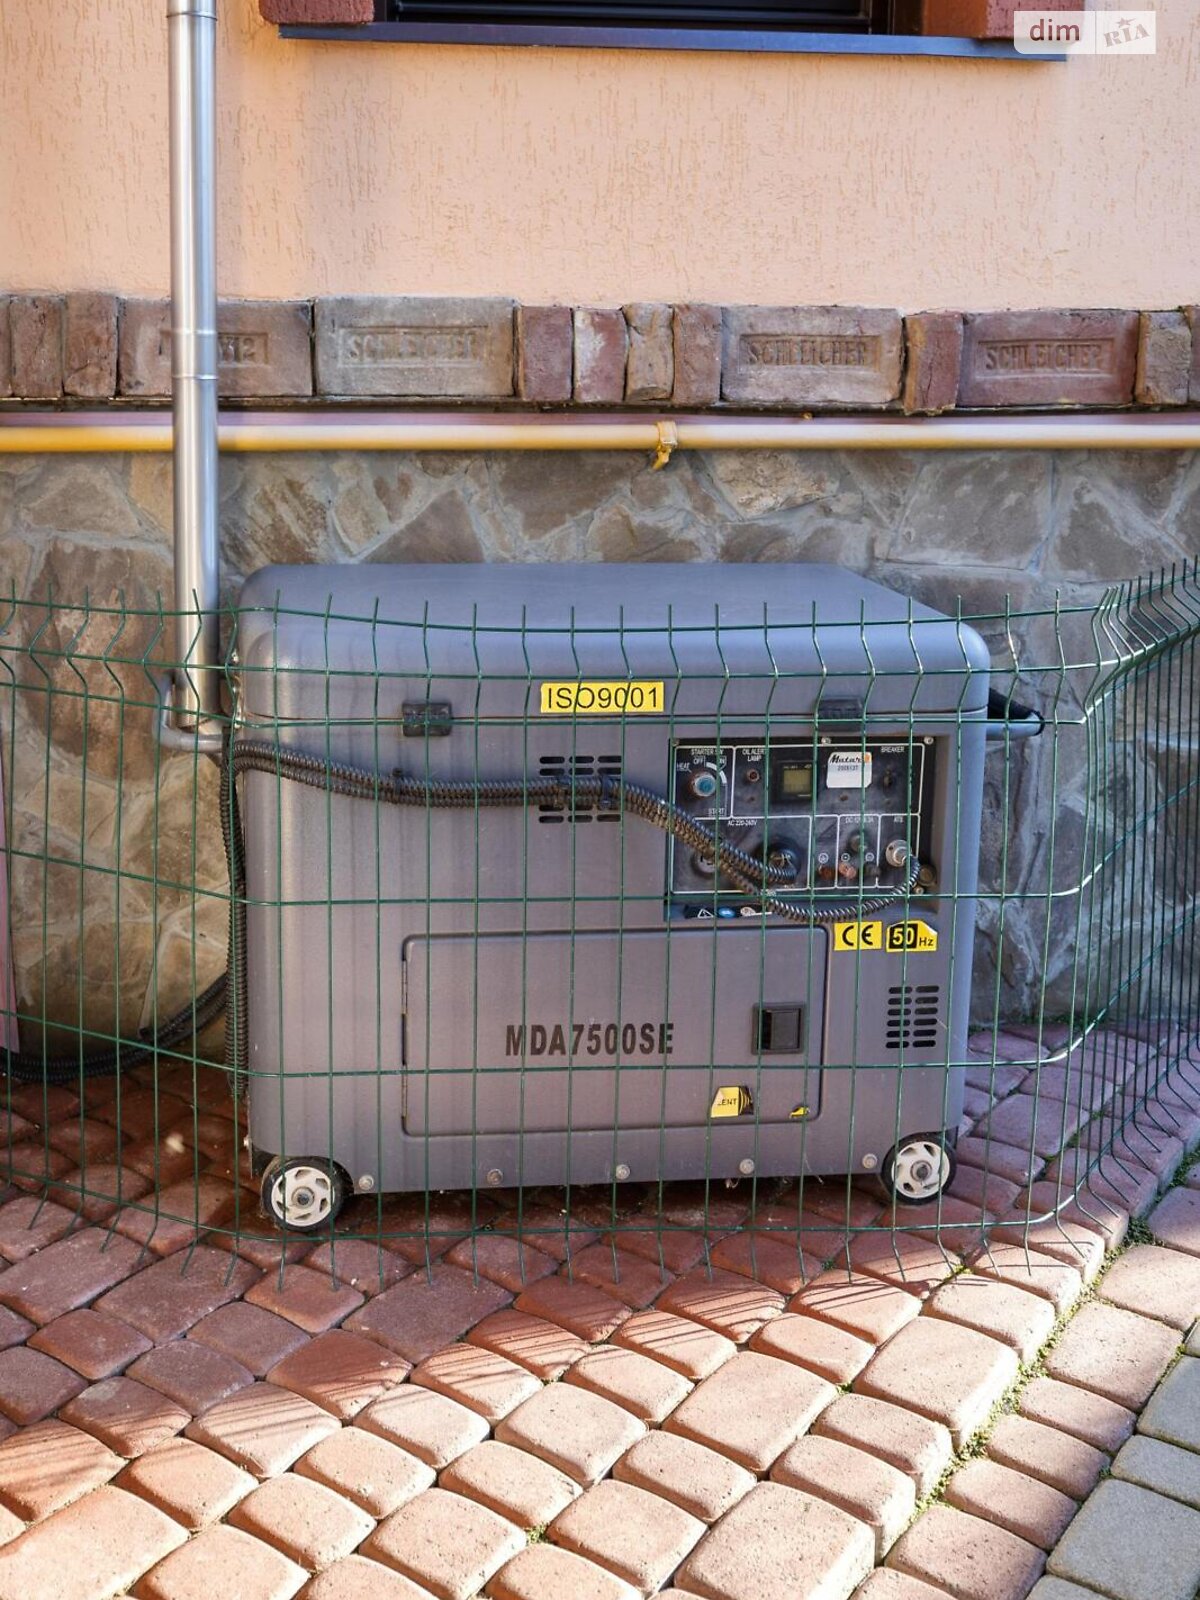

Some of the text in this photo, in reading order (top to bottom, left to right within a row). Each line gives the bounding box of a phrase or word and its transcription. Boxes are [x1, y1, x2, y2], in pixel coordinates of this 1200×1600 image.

[548, 687, 658, 709] ISO9001
[842, 924, 874, 947] CE
[892, 927, 934, 947] 50 Hz
[505, 1022, 674, 1057] MDA7500SE
